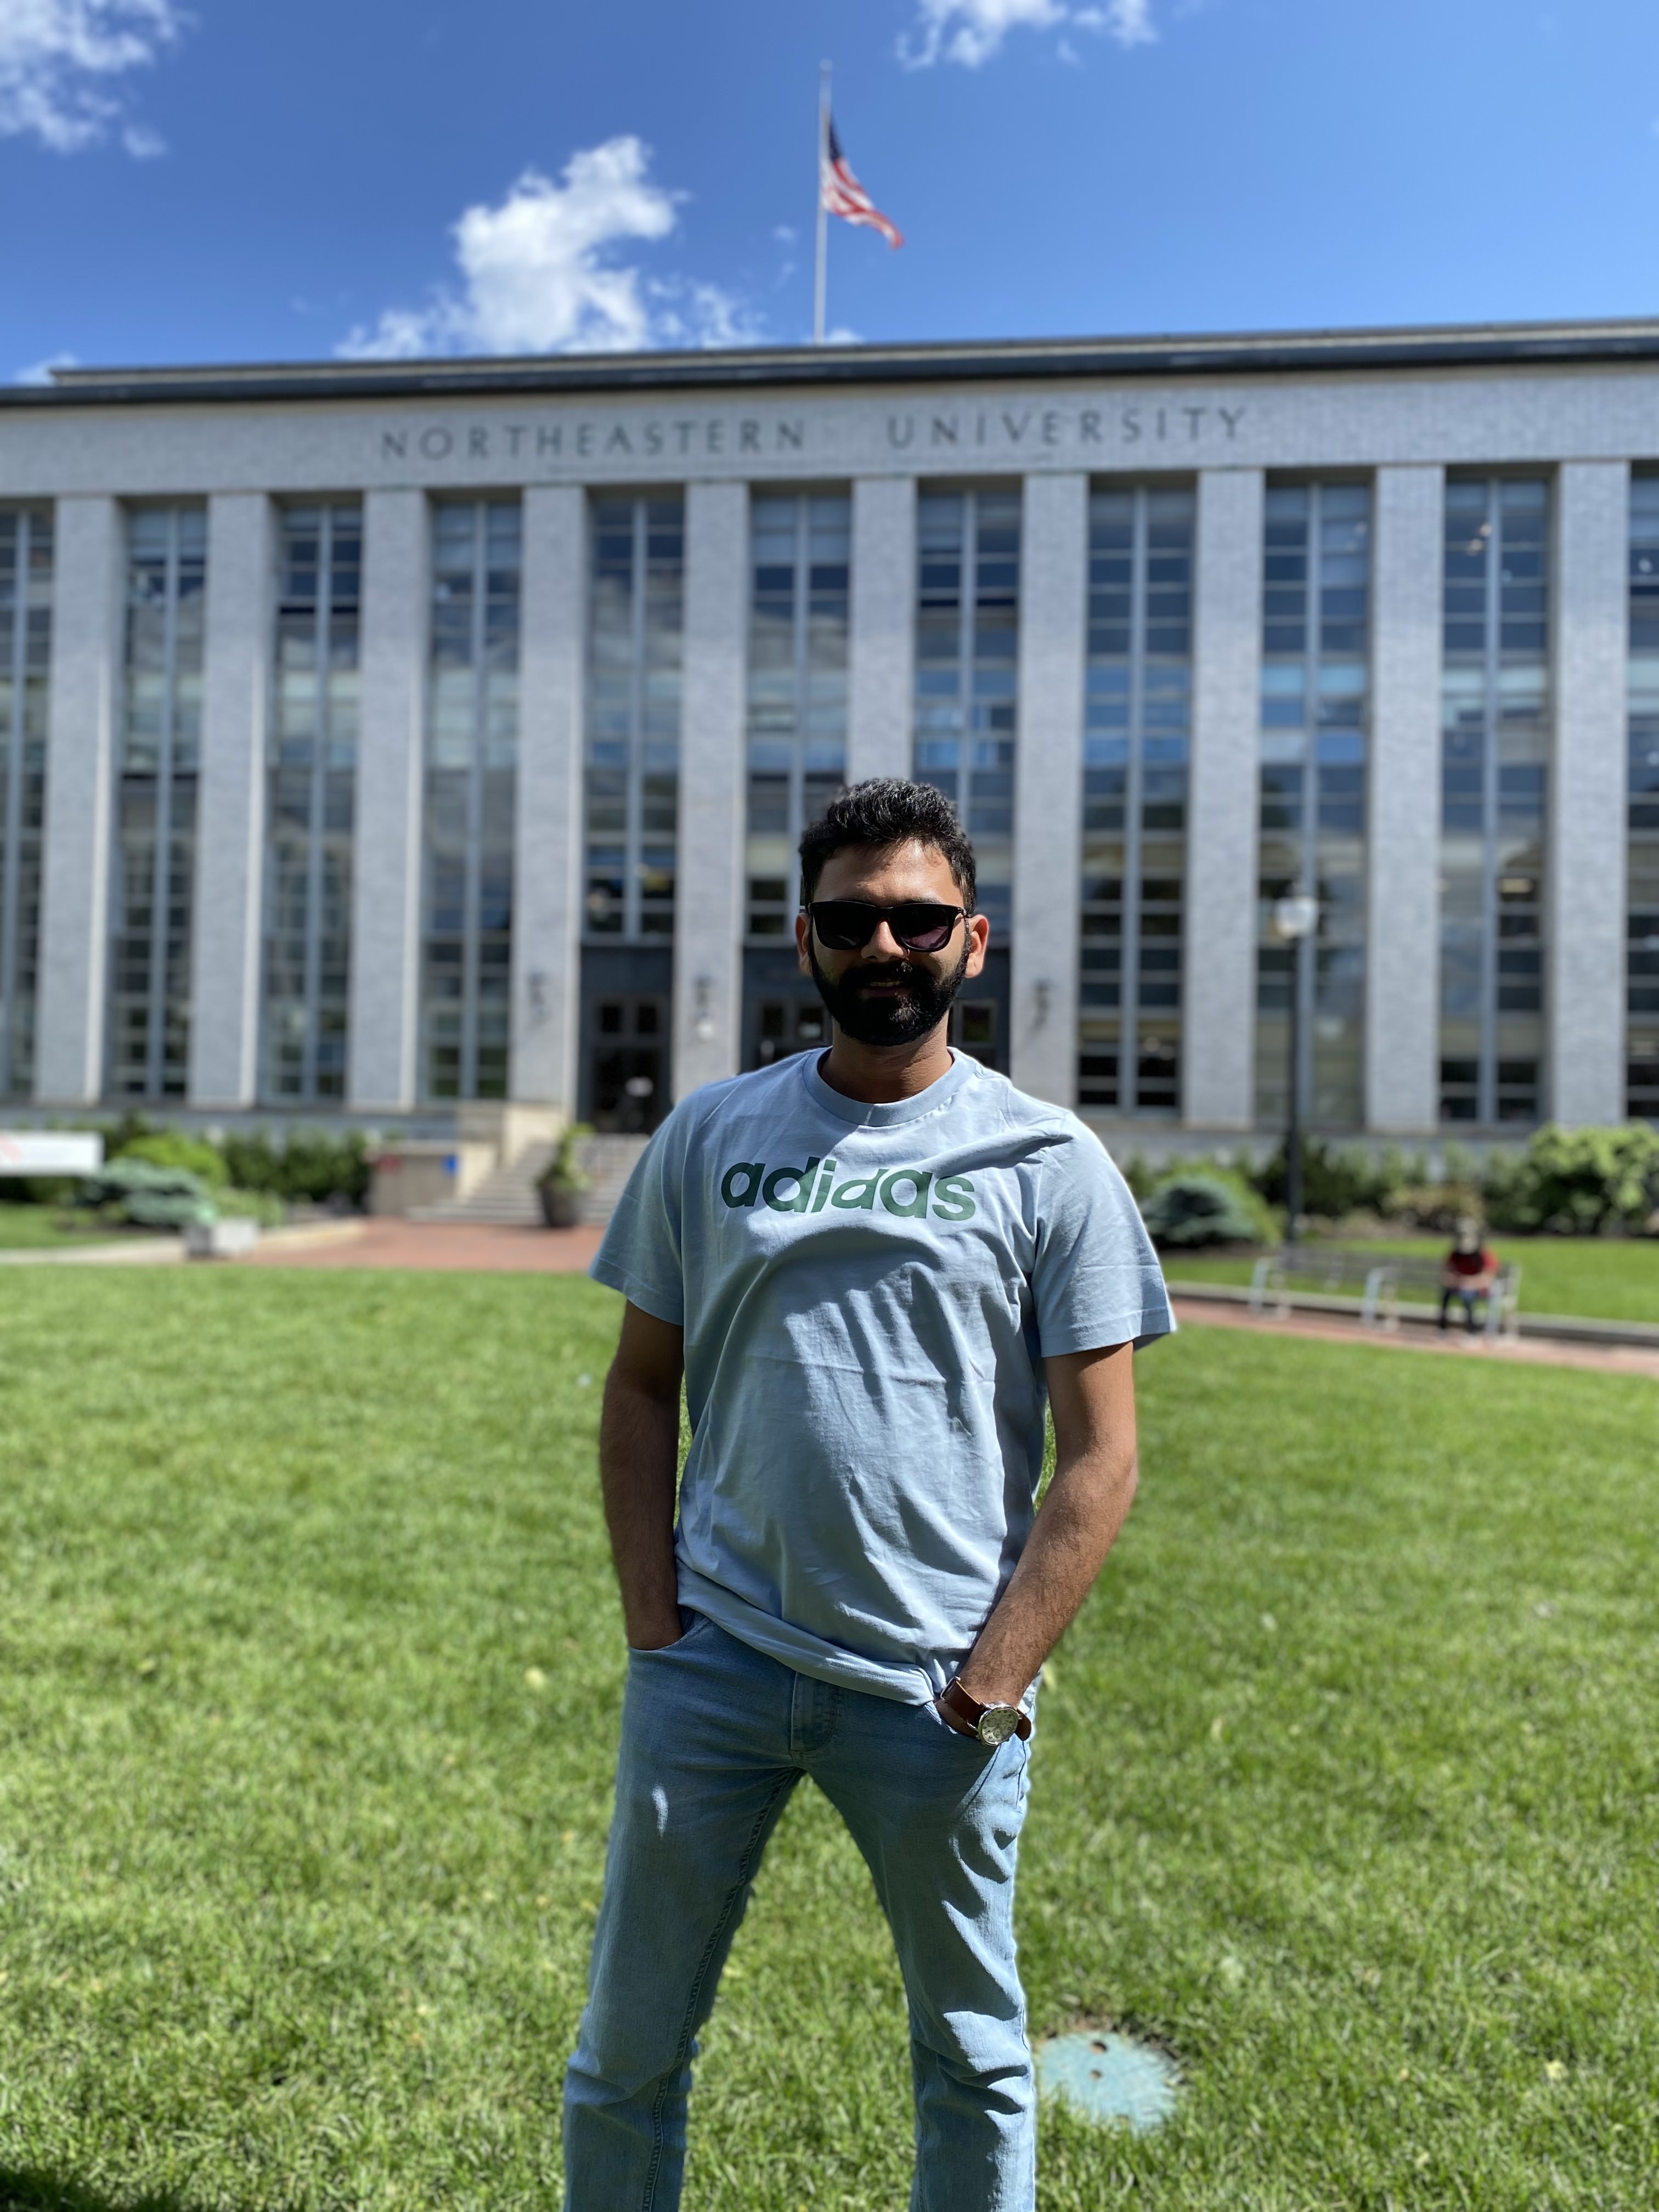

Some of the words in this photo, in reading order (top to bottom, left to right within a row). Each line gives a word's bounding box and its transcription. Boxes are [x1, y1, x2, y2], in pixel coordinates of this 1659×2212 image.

[382, 419, 805, 461] NORTHEASTERN
[887, 407, 1246, 448] UNIVERSITY
[721, 1156, 977, 1221] adidas
